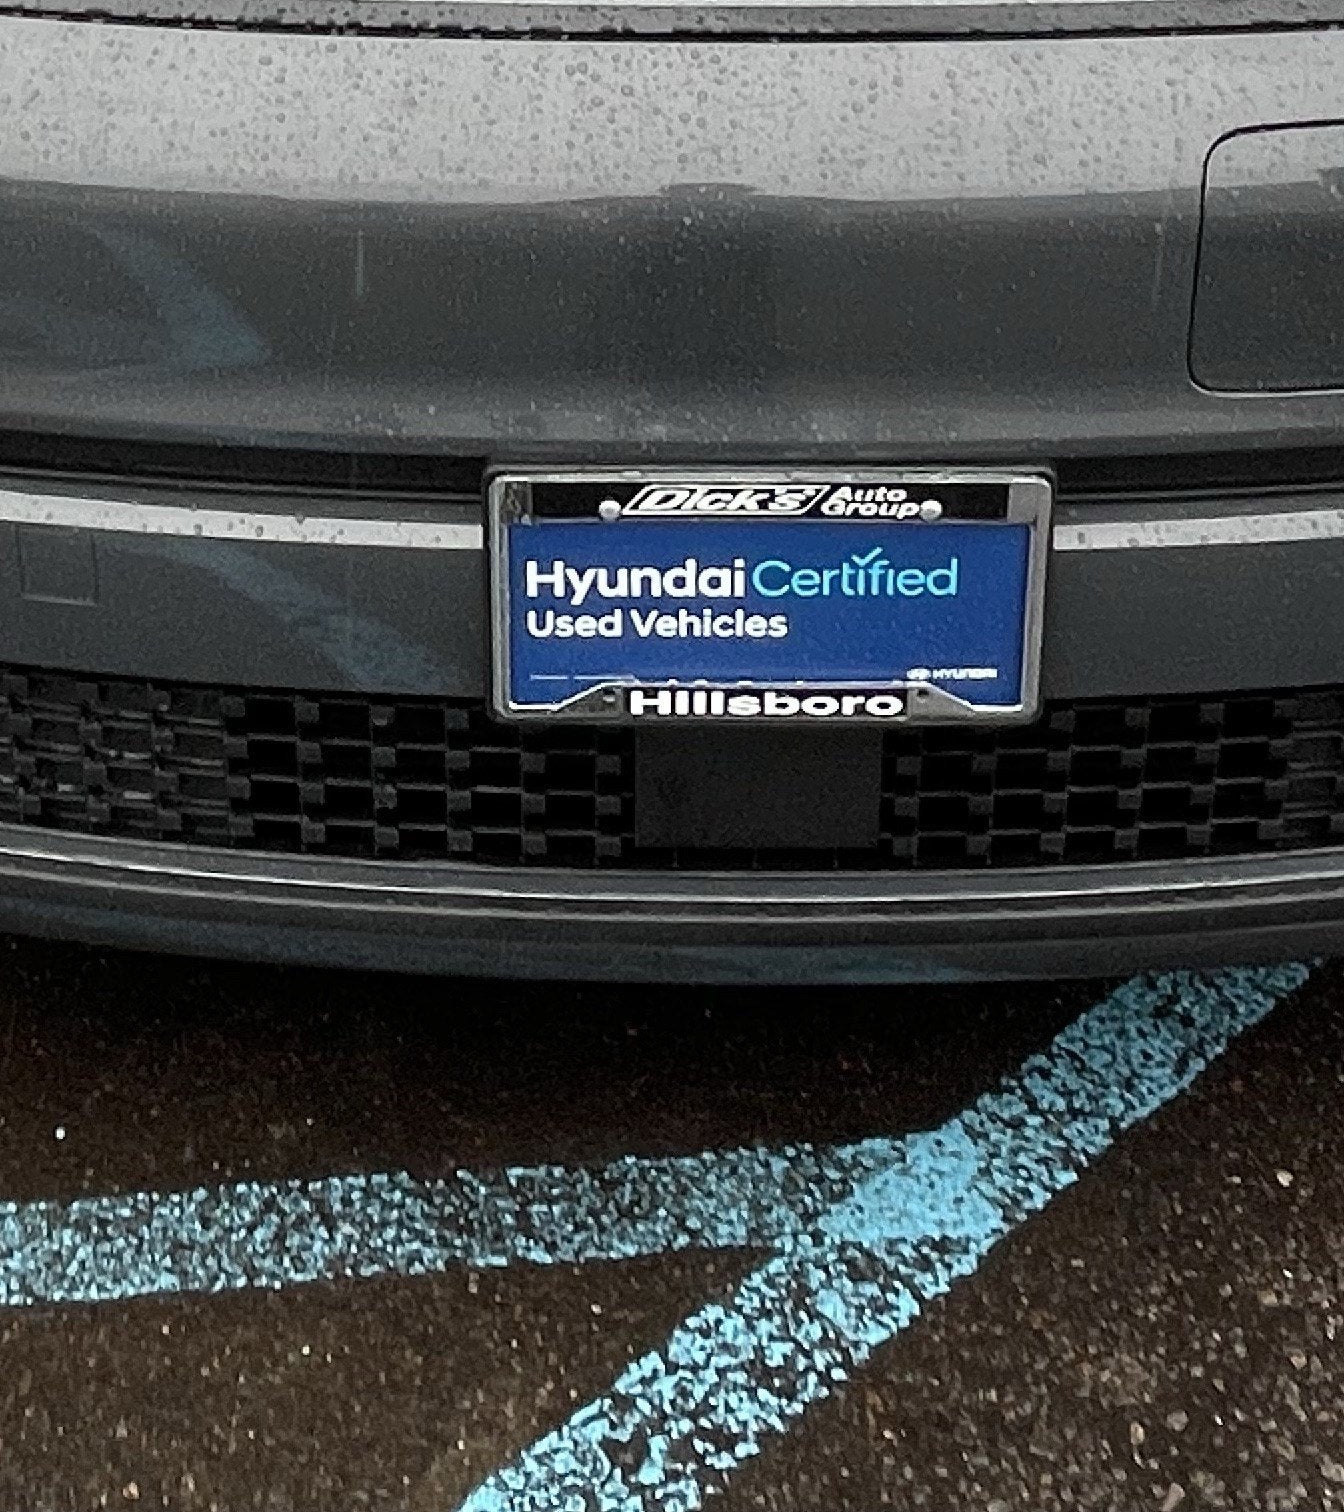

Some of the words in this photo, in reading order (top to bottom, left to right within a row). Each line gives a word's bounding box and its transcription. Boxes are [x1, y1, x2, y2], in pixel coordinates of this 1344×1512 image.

[831, 486, 908, 502] Auto
[820, 499, 921, 520] Group
[525, 559, 745, 605] Hyundai
[752, 547, 958, 597] Certified
[527, 609, 622, 638] Used
[631, 608, 789, 638] Vehicles
[629, 689, 905, 717] Hillsboro
